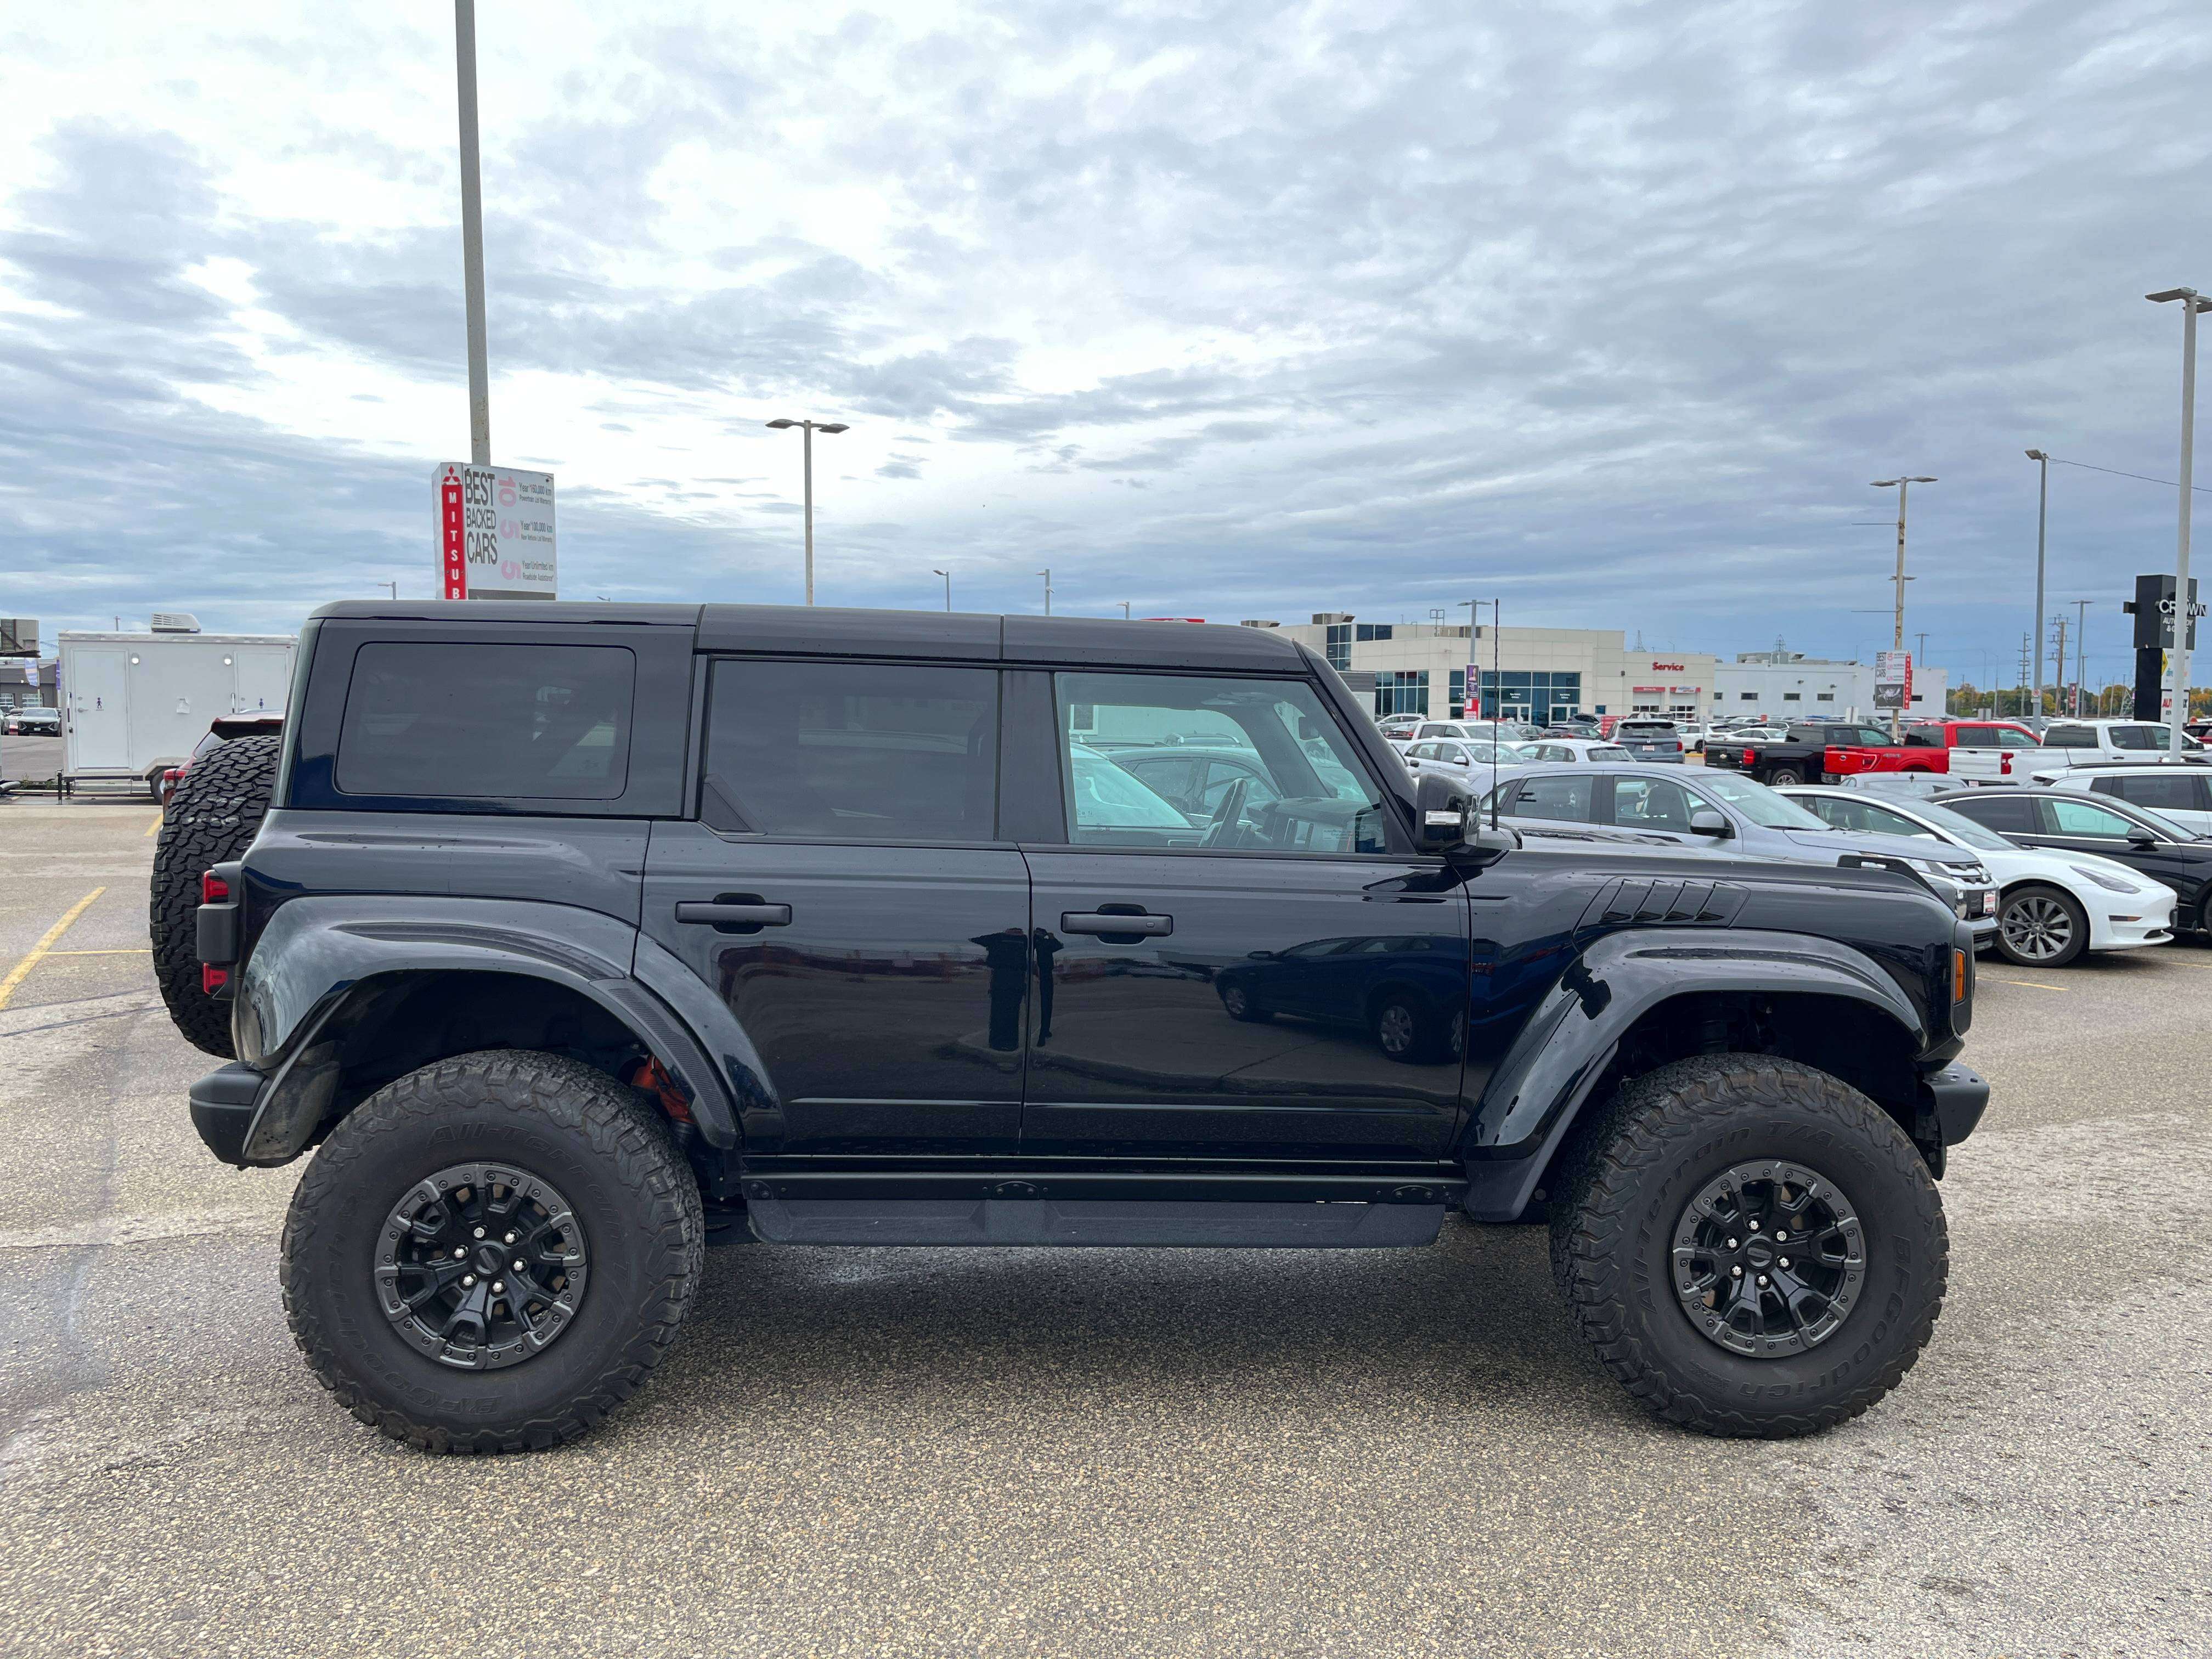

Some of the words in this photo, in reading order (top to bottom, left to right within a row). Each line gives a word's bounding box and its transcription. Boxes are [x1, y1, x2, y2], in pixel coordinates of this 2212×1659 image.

[465, 470, 495, 506] BEST
[466, 507, 496, 530] BACKED
[449, 492, 460, 600] MITSUB
[467, 531, 498, 565] CARS
[1652, 661, 1685, 671] Service
